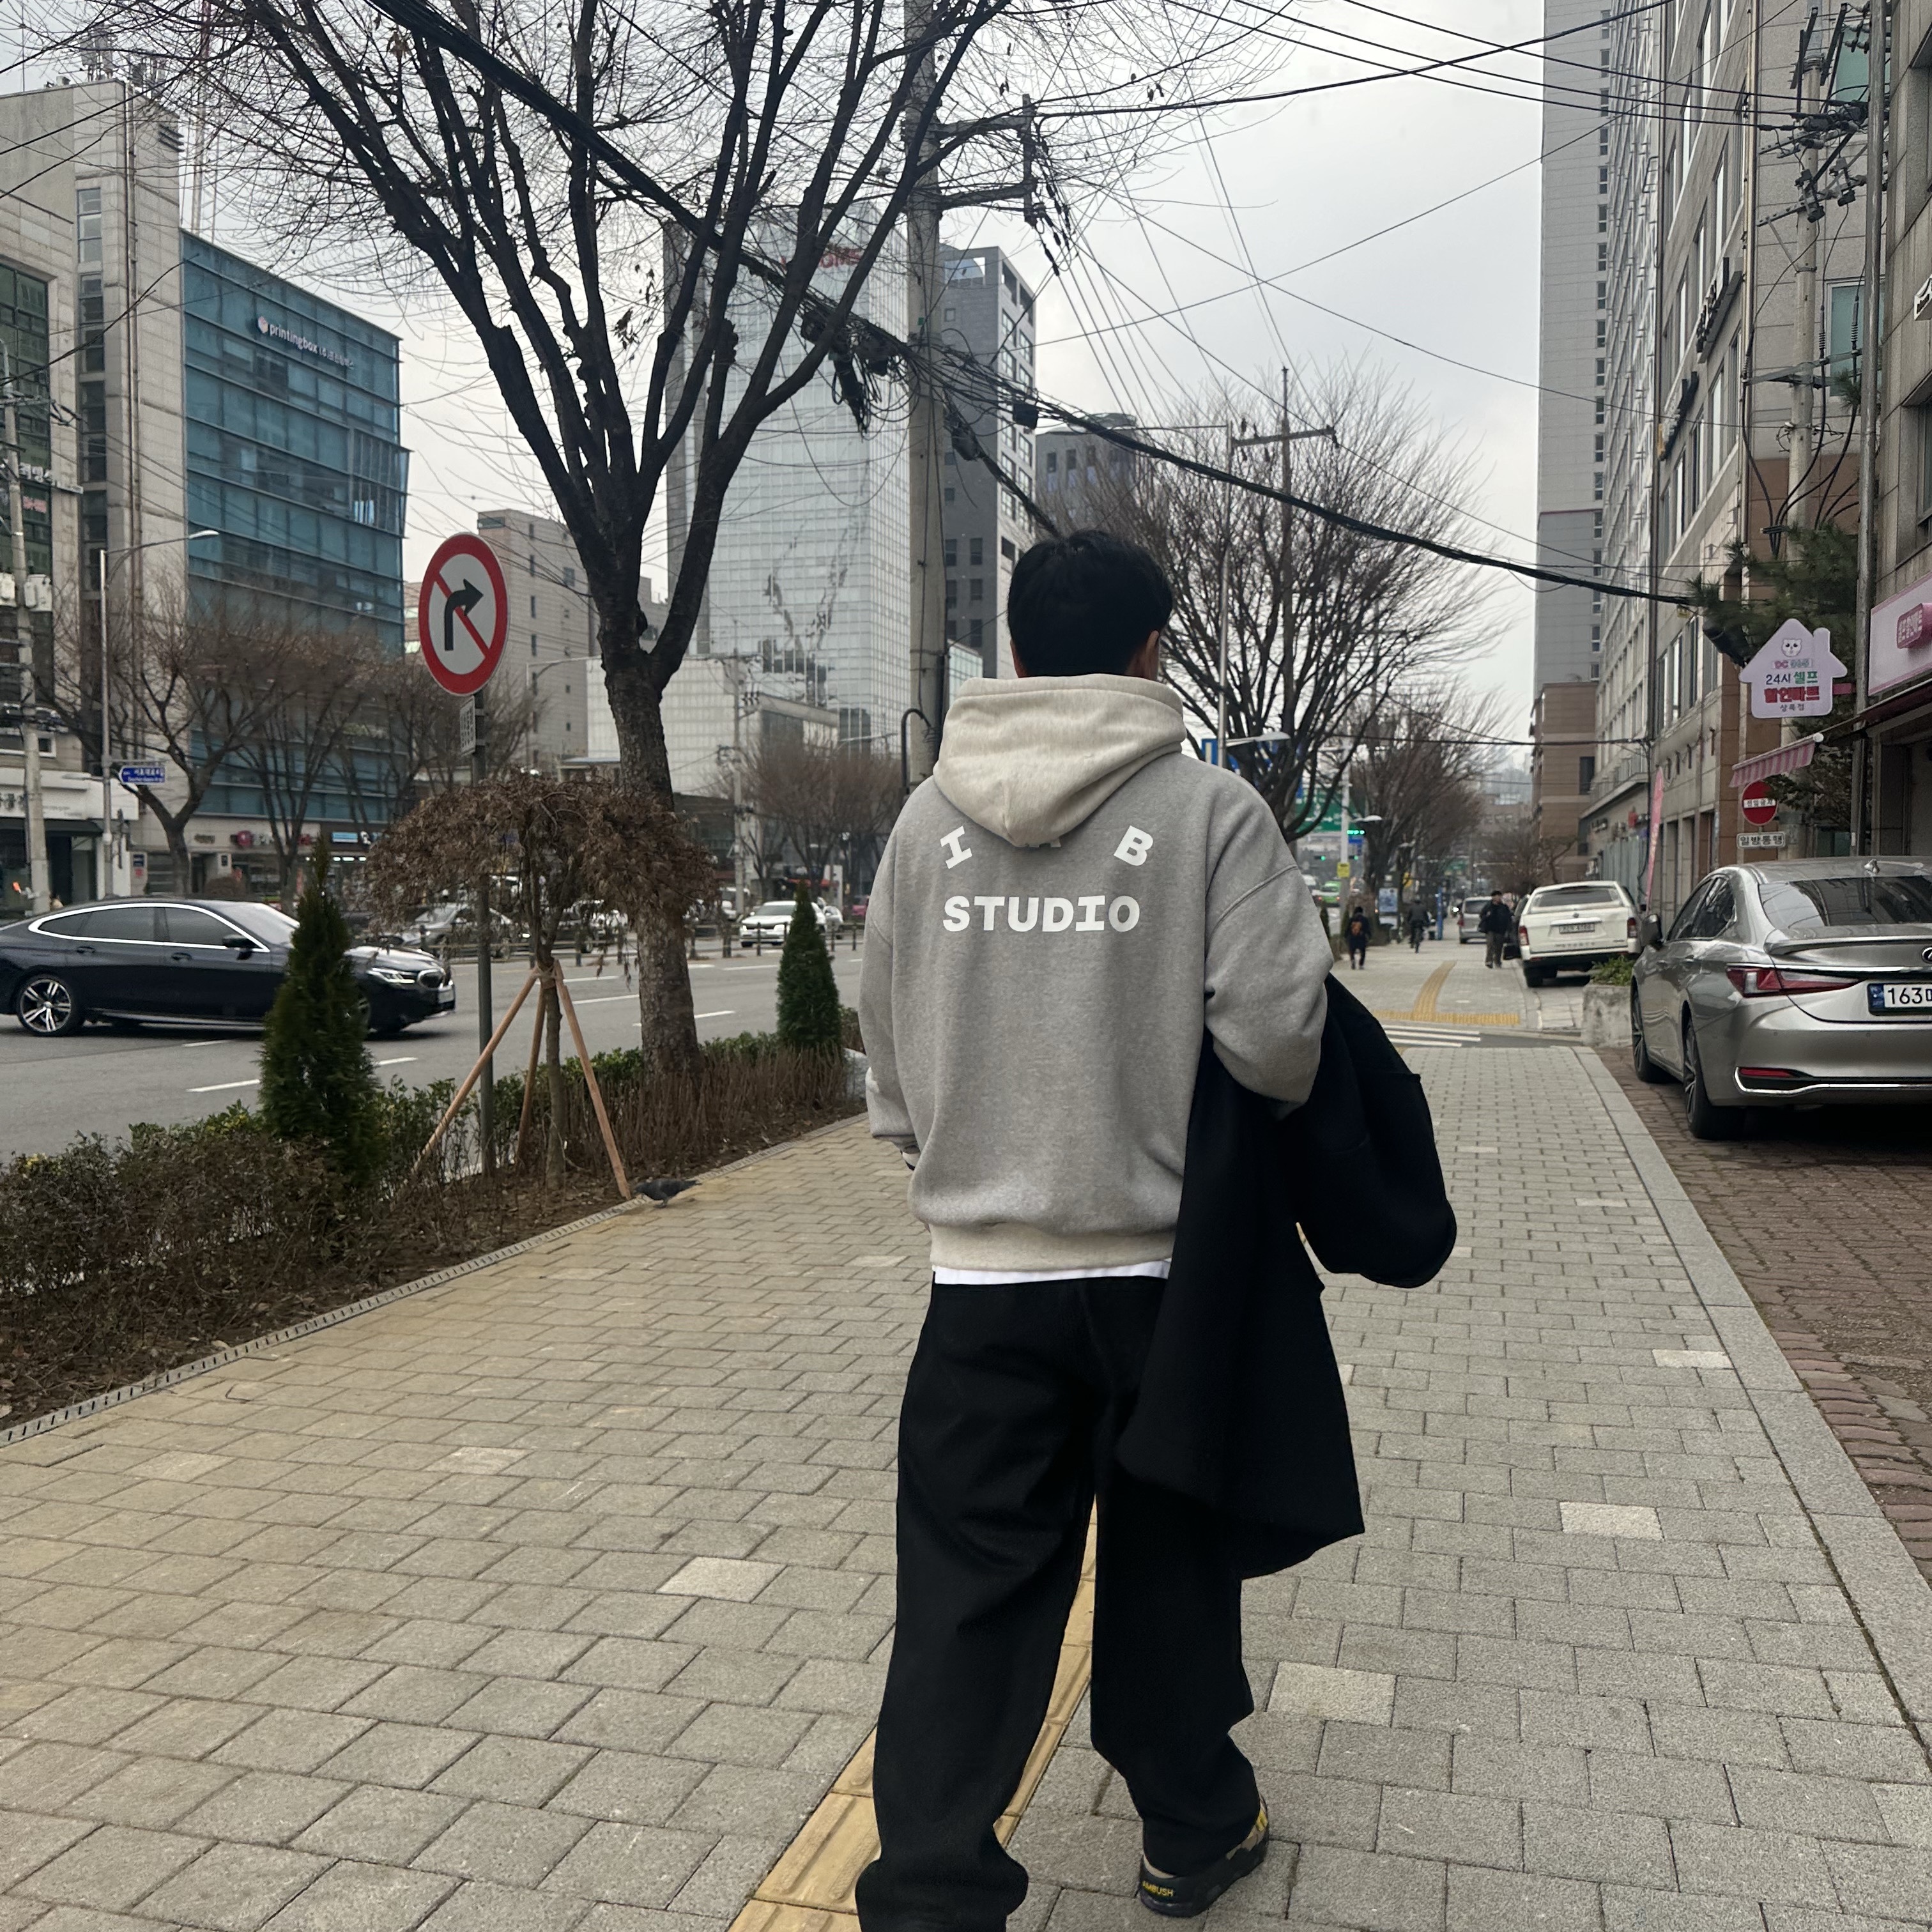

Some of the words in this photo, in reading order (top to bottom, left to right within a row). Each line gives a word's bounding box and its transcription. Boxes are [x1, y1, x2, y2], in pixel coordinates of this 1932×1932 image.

[270, 323, 318, 354] printingbox
[1765, 673, 1791, 685] 24시
[1793, 671, 1818, 684] 셀프
[1740, 835, 1782, 846] 일방통행
[942, 895, 1140, 932] STUDIO
